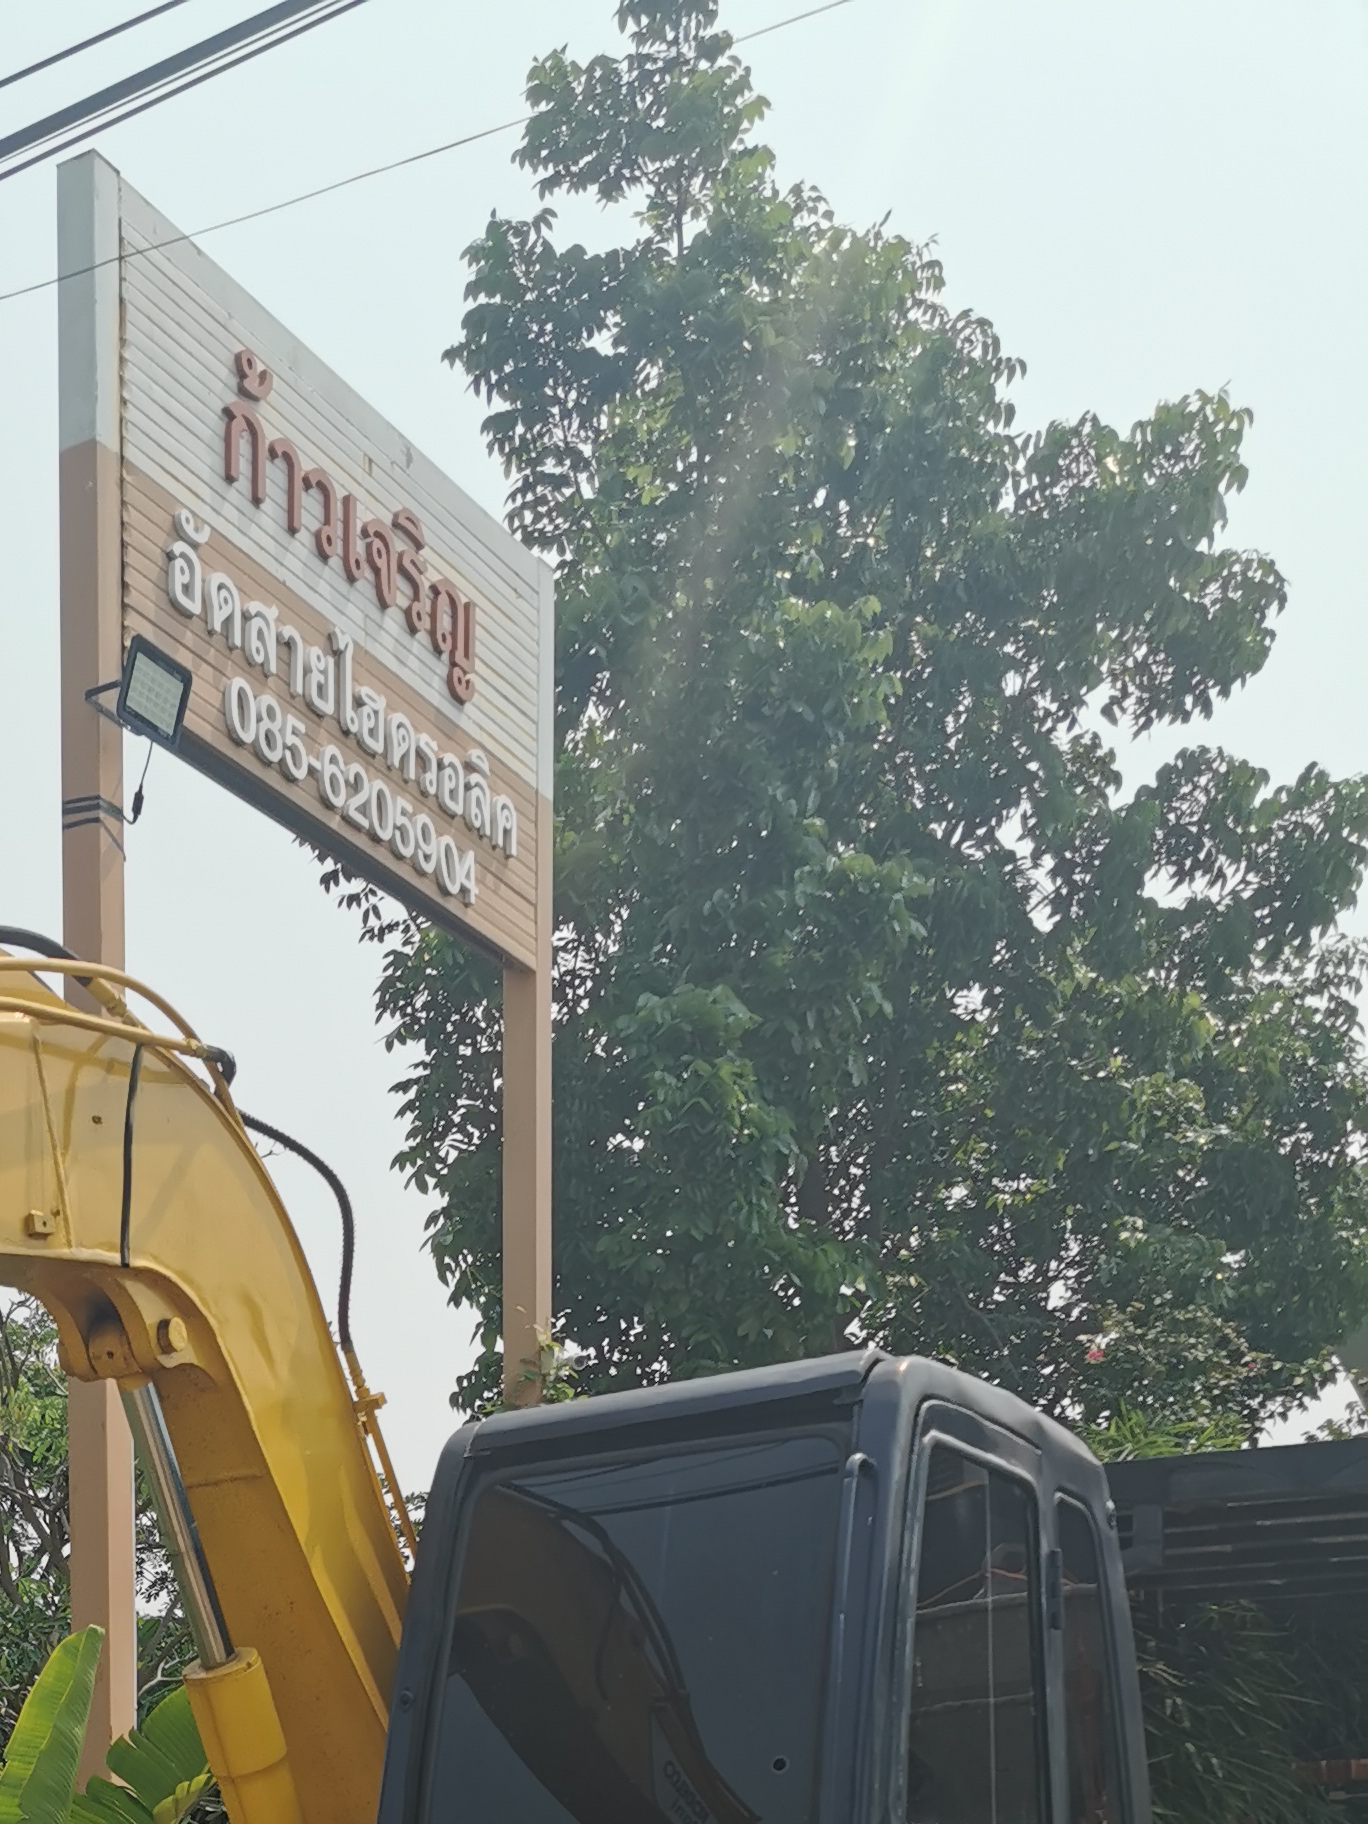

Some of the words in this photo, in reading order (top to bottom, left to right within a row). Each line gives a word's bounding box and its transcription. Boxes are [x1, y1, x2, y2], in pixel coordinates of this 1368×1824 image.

[166, 509, 518, 858] อัดสายไฮดรอลิค
[222, 350, 476, 705] ก้าวเจริญ
[224, 676, 479, 906] 085-6205904
